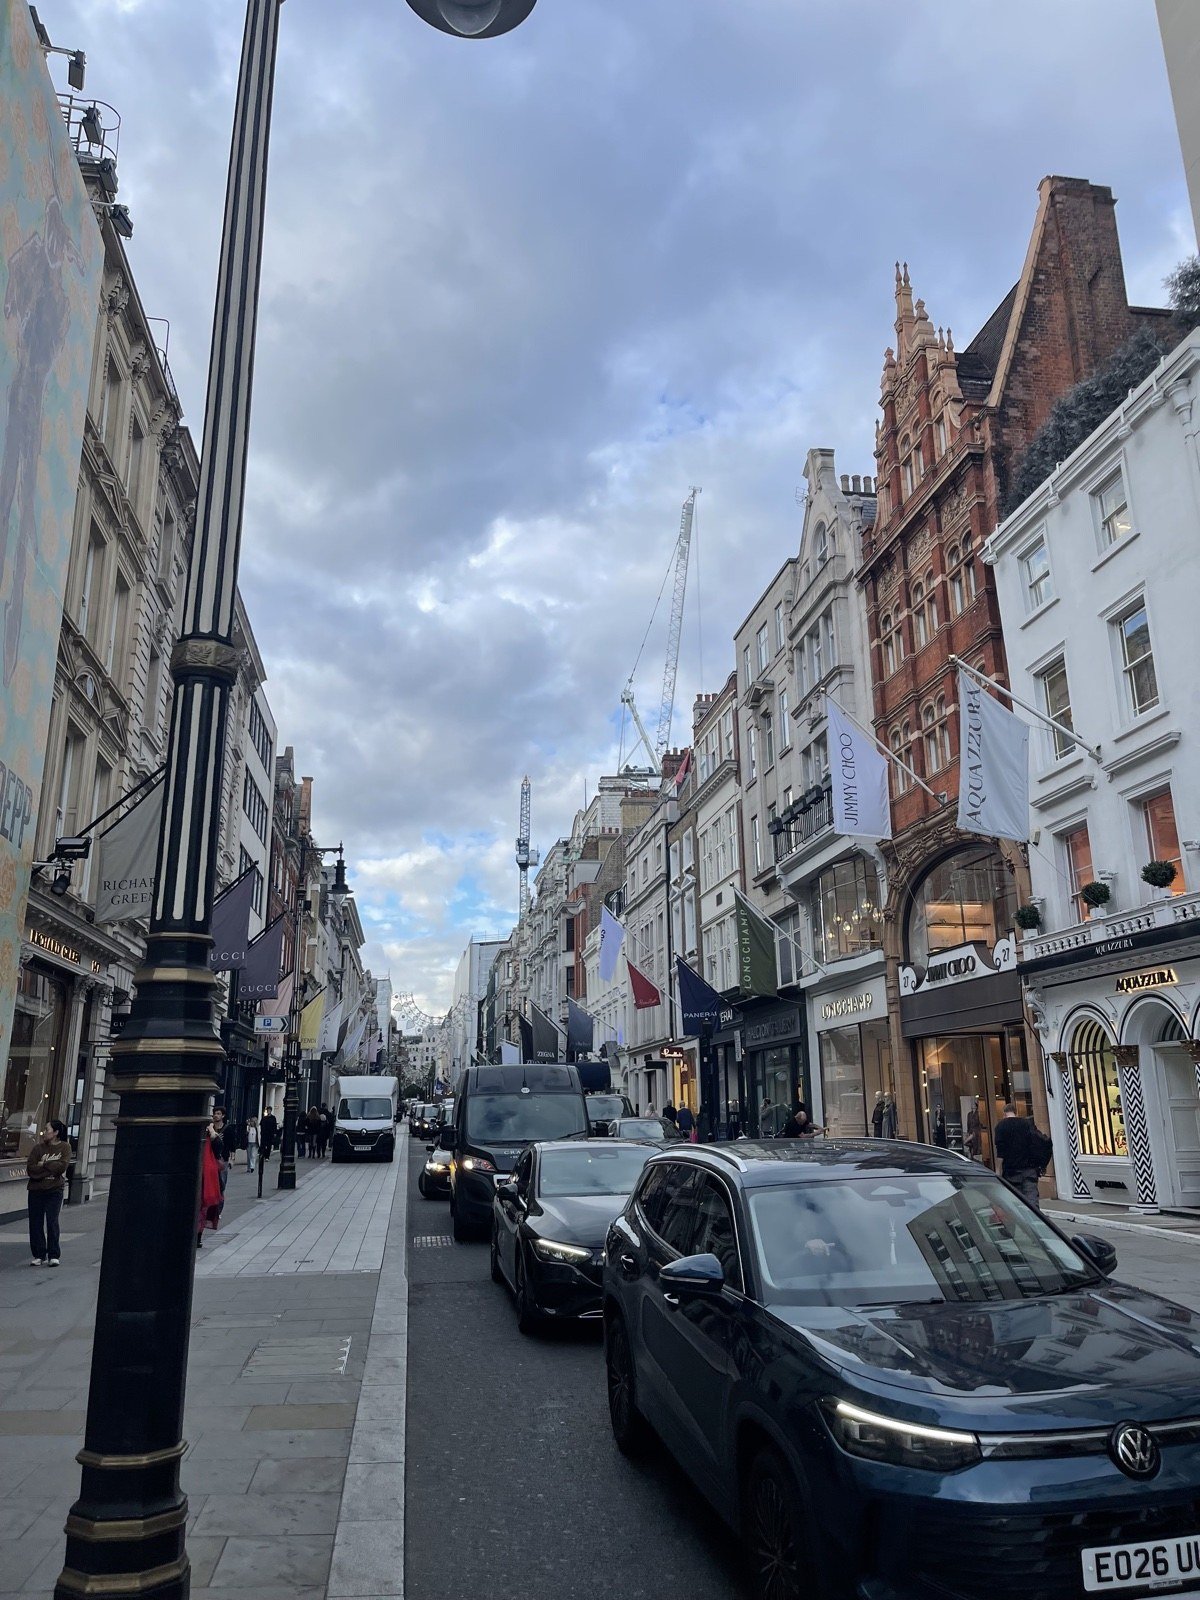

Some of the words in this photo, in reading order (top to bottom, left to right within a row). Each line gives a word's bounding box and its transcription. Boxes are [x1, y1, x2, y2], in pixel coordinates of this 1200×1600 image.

[839, 732, 857, 780] CHOO
[966, 688, 987, 825] AQUAZZURA
[843, 783, 859, 826] JIMMY
[103, 877, 155, 891] RICHAR
[740, 909, 752, 989] LONGCHAMP
[1094, 938, 1134, 955] AQUAZZURA
[210, 951, 246, 961] UCCI
[1002, 948, 1010, 962] 27
[240, 984, 277, 993] GUCCI
[902, 975, 910, 988] 27
[1115, 968, 1177, 993] AQUAZZURA
[820, 992, 873, 1020] LONGCHAMP
[683, 1010, 718, 1019] PANERAI
[720, 1008, 733, 1023] ERAI
[536, 1051, 555, 1059] ZEGNA
[1094, 1545, 1170, 1583] EO26
